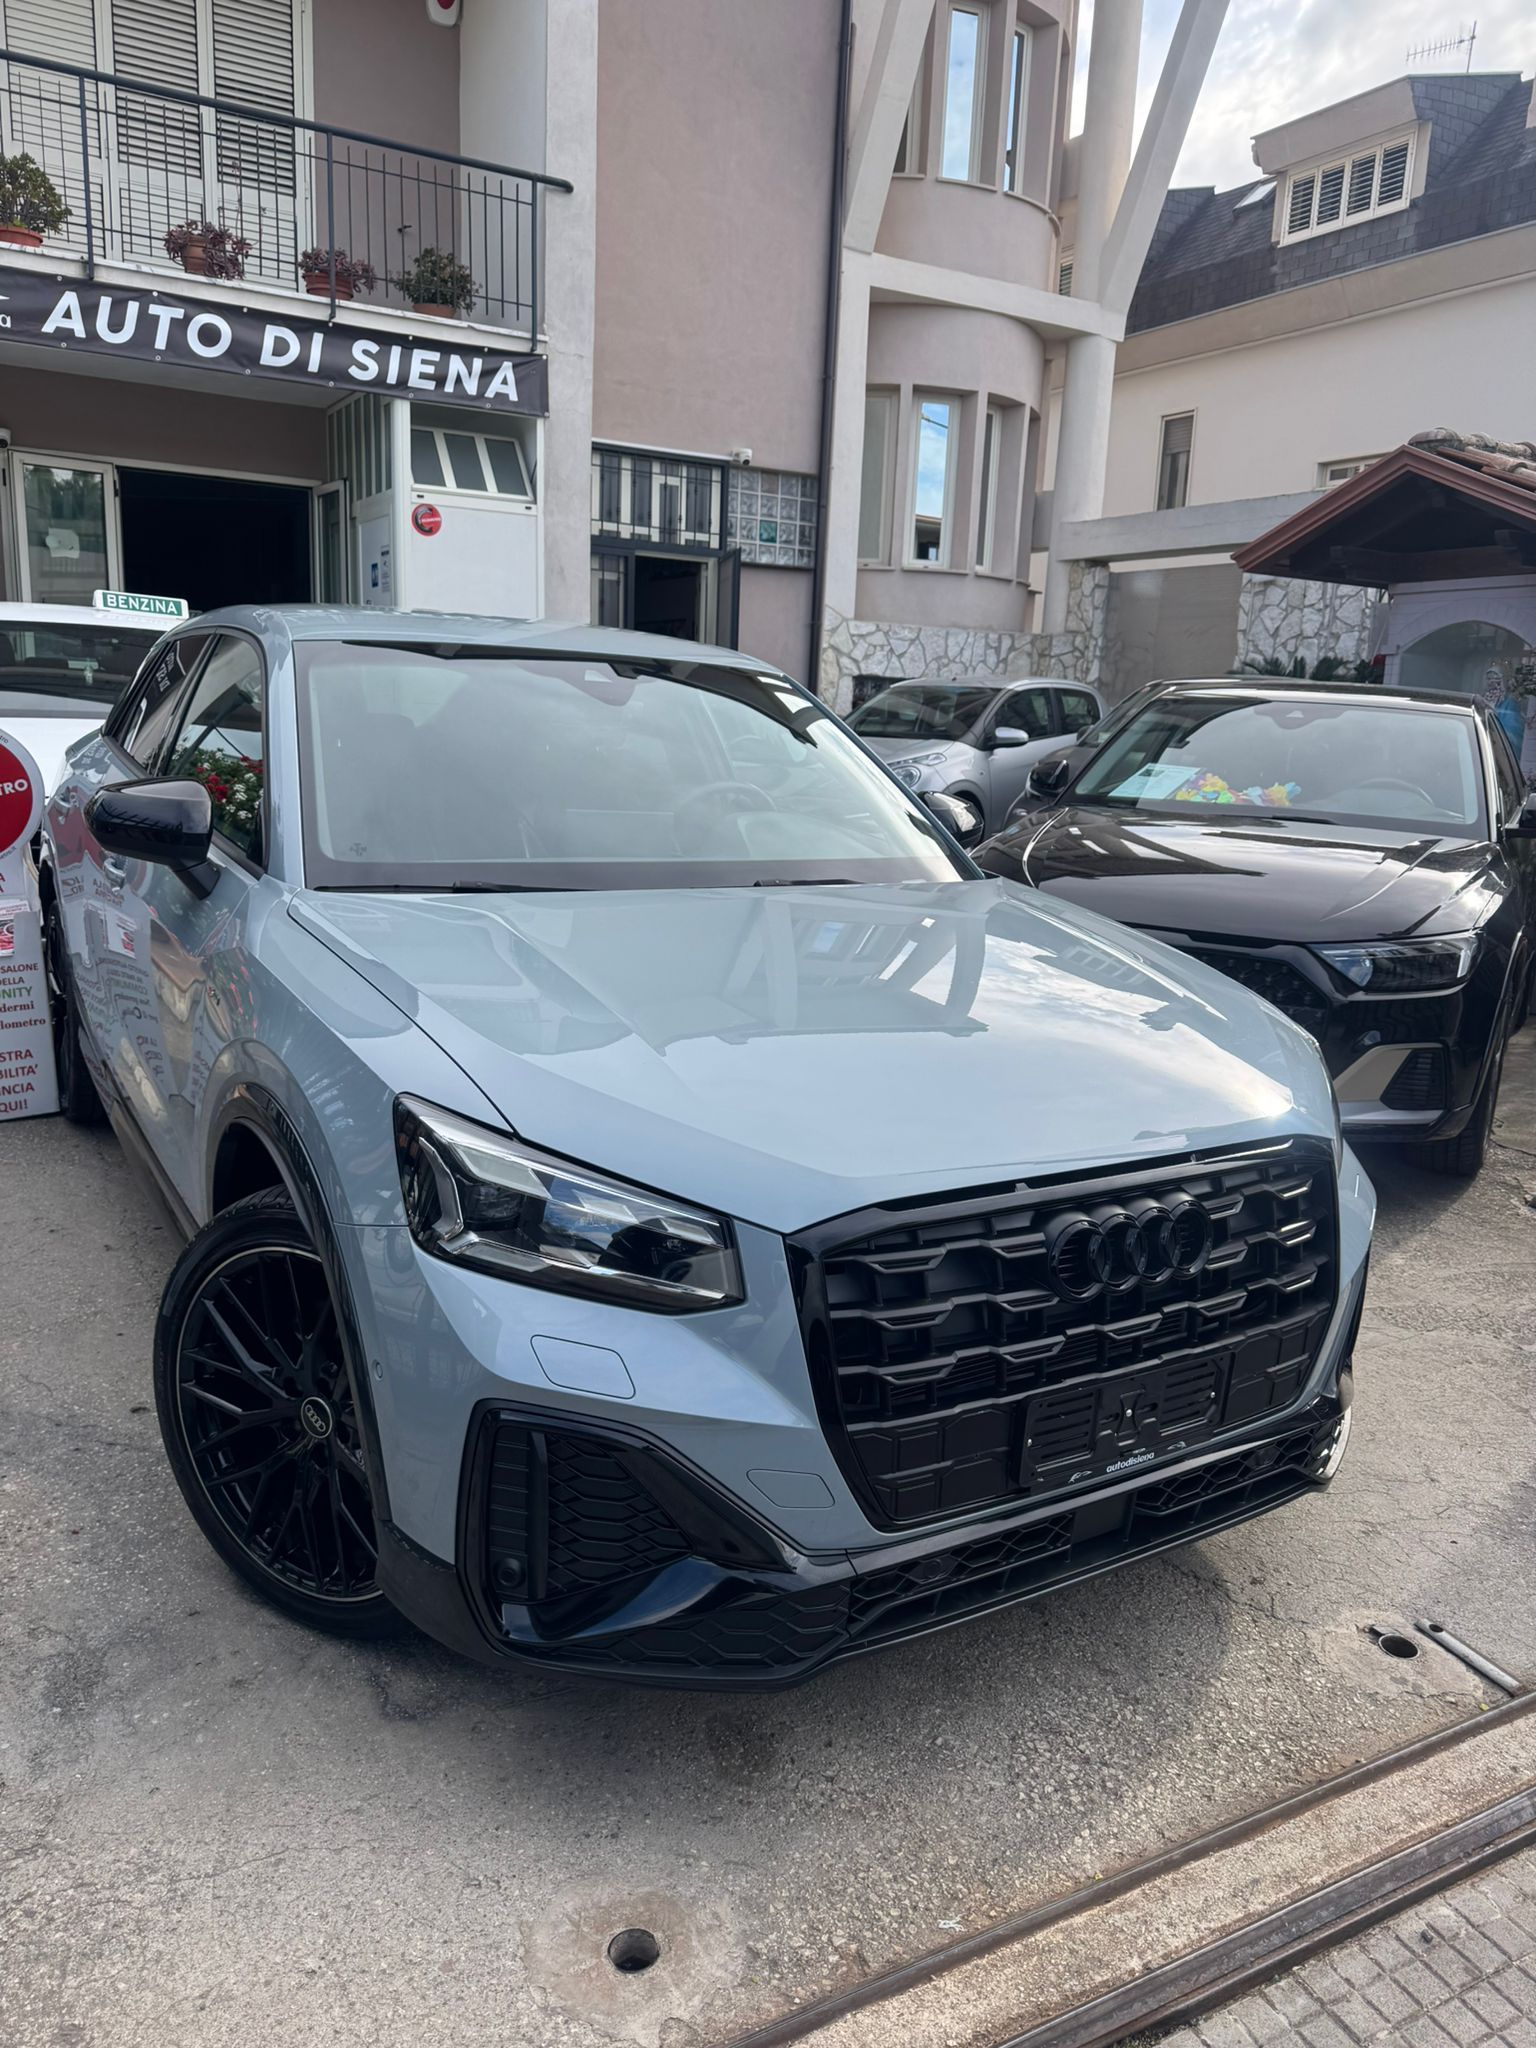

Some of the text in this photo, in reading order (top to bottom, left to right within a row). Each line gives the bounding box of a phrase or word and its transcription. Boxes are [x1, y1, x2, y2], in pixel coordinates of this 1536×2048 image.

[41, 291, 518, 401] AUTO DI SIENA
[106, 594, 178, 614] BENZINA
[0, 963, 39, 974] SALONE
[0, 986, 33, 999] NITY
[0, 1082, 35, 1096] NCIA
